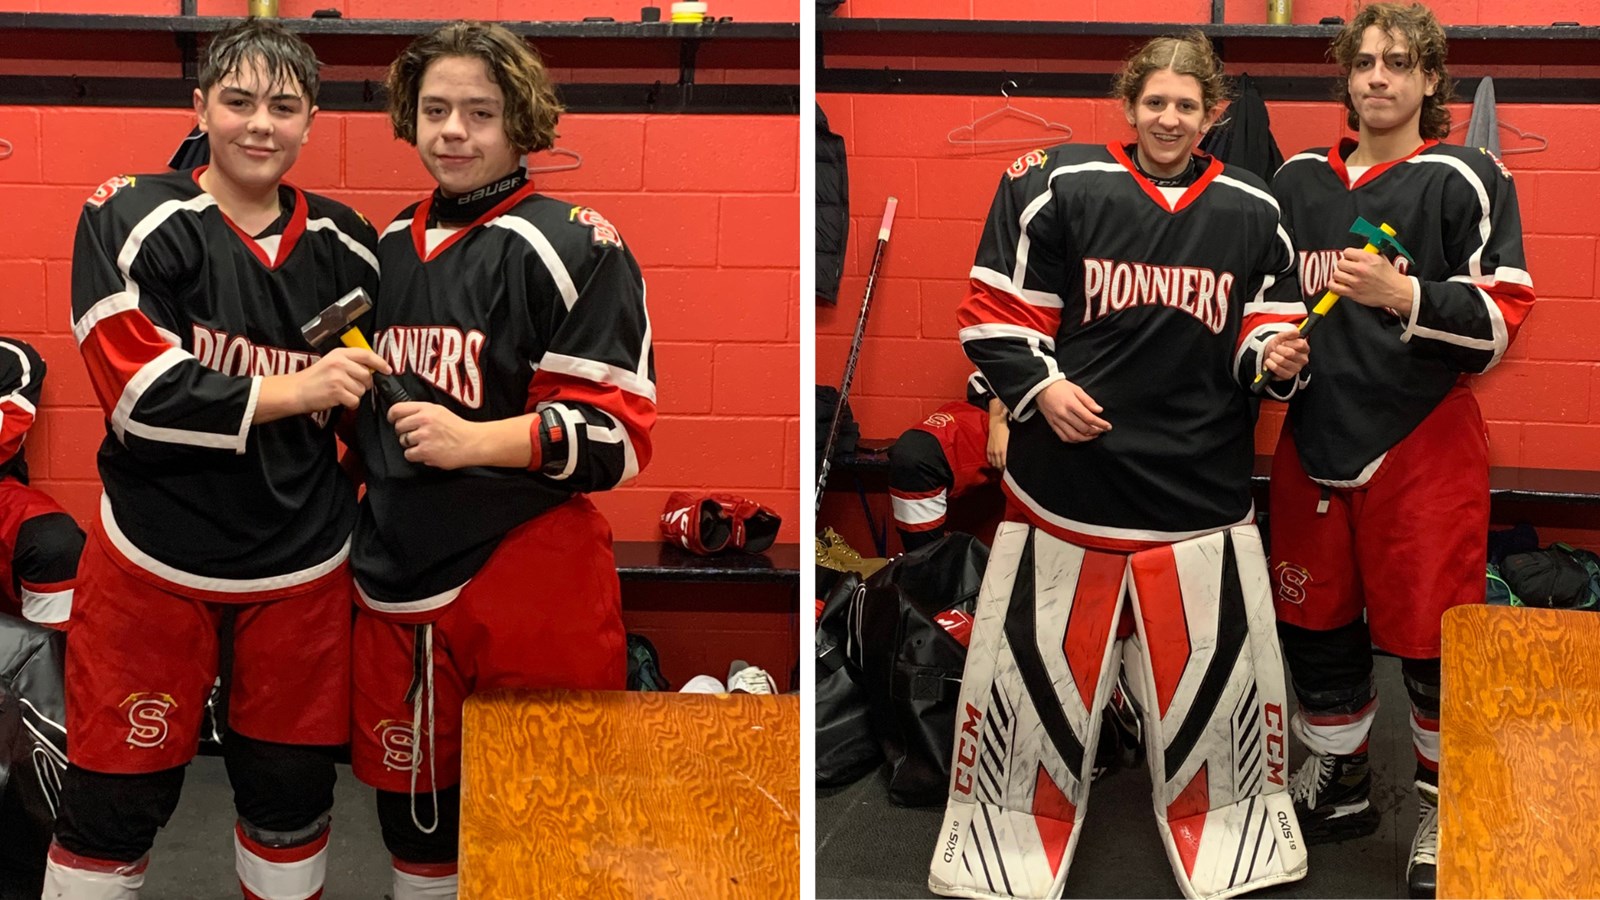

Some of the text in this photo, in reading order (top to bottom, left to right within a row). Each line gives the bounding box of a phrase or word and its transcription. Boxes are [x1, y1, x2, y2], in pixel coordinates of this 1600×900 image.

[1081, 257, 1235, 335] PIONNIERS
[954, 702, 982, 796] CCM
[1264, 702, 1284, 786] CCM
